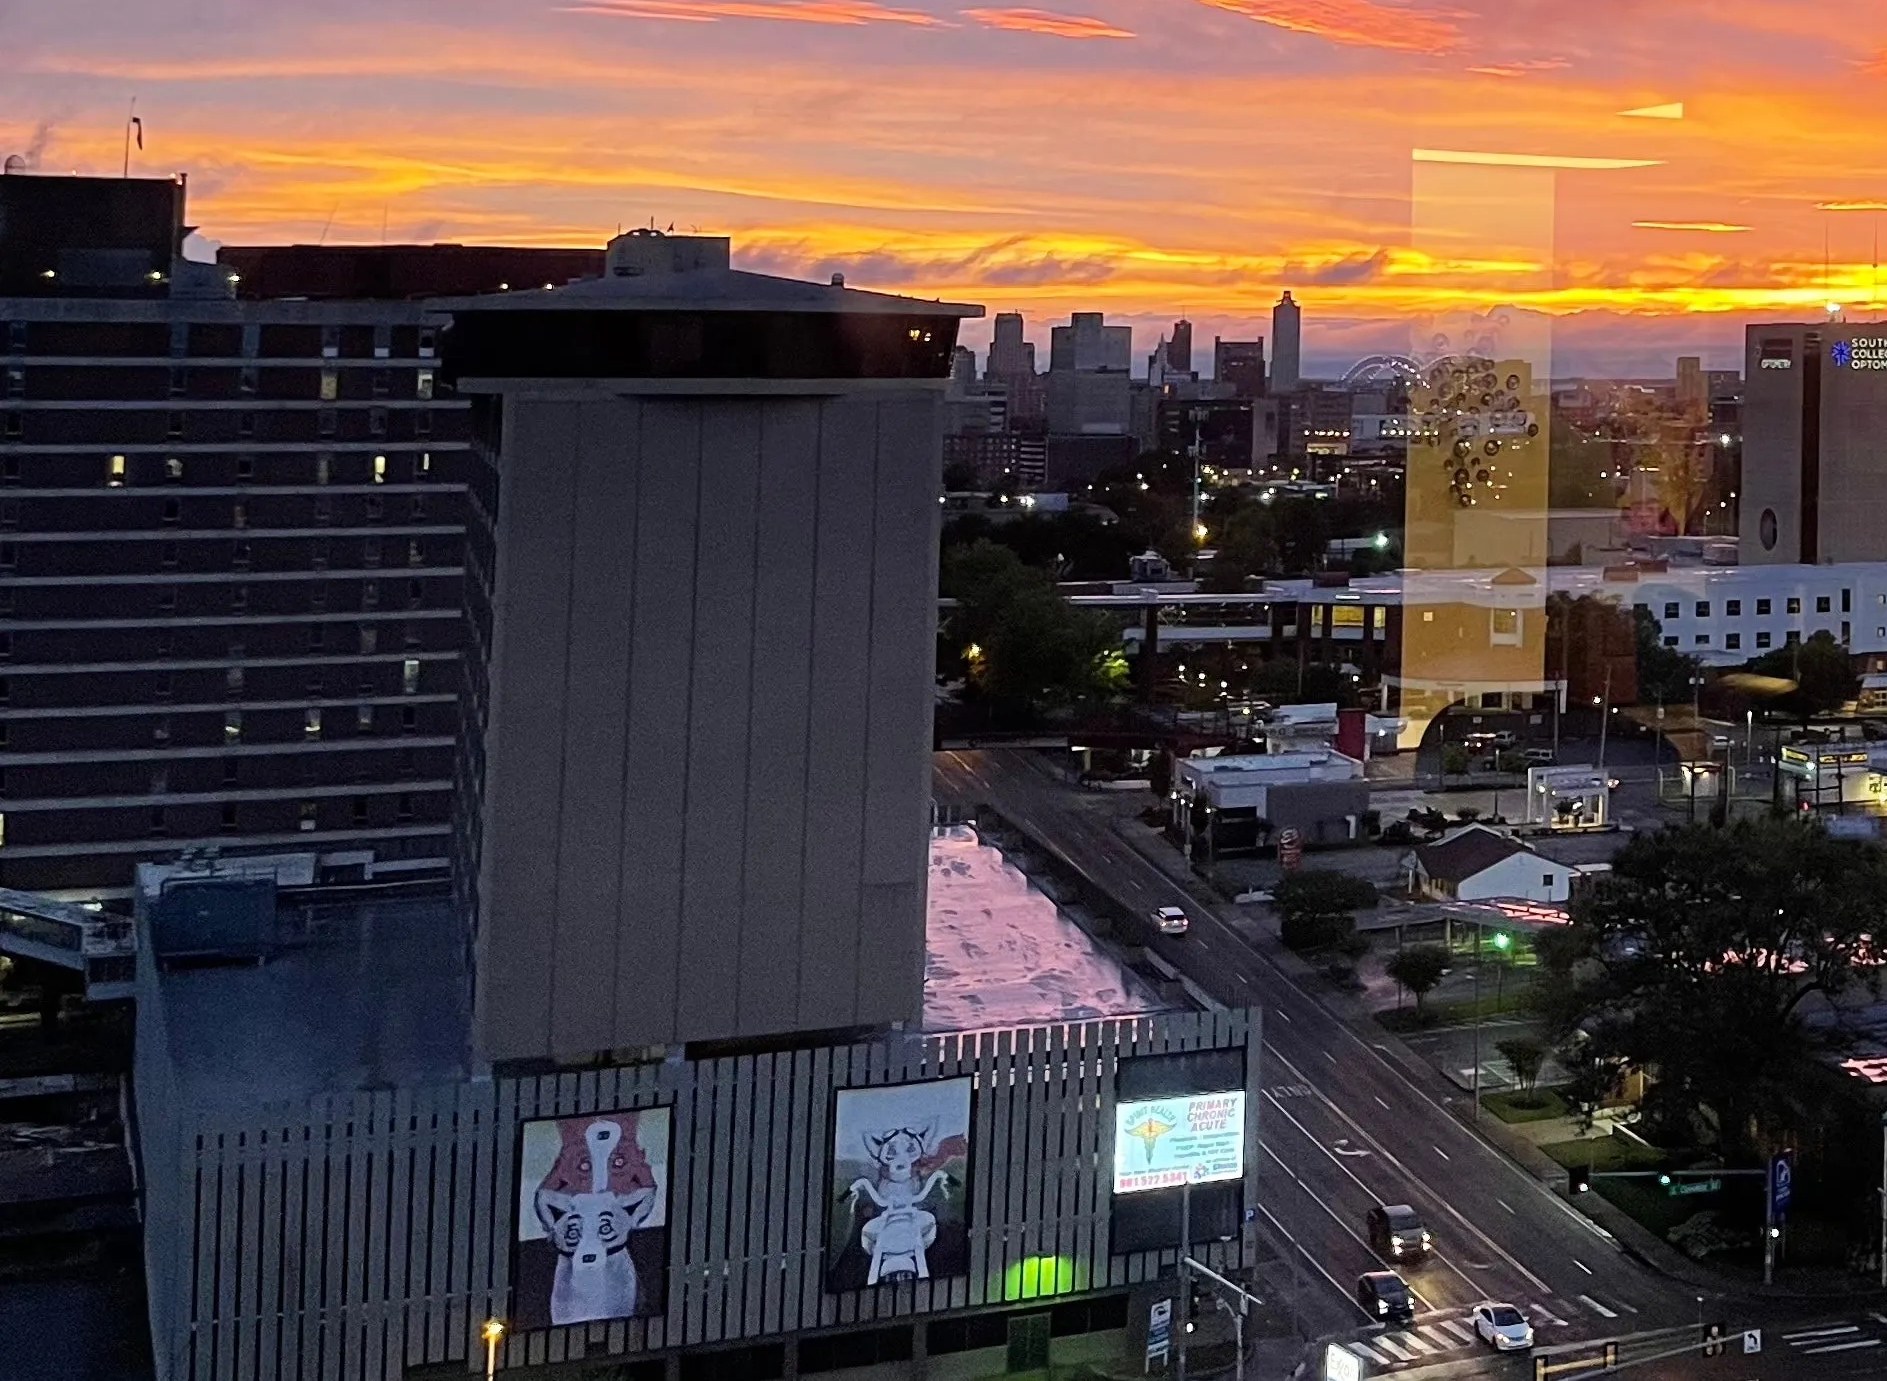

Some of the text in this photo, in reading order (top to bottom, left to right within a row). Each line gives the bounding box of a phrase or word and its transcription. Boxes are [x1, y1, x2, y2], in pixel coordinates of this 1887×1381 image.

[1188, 1098, 1238, 1112] PRIMARY
[1187, 1108, 1235, 1122] CHRONIC
[1191, 1119, 1227, 1132] ACUTE
